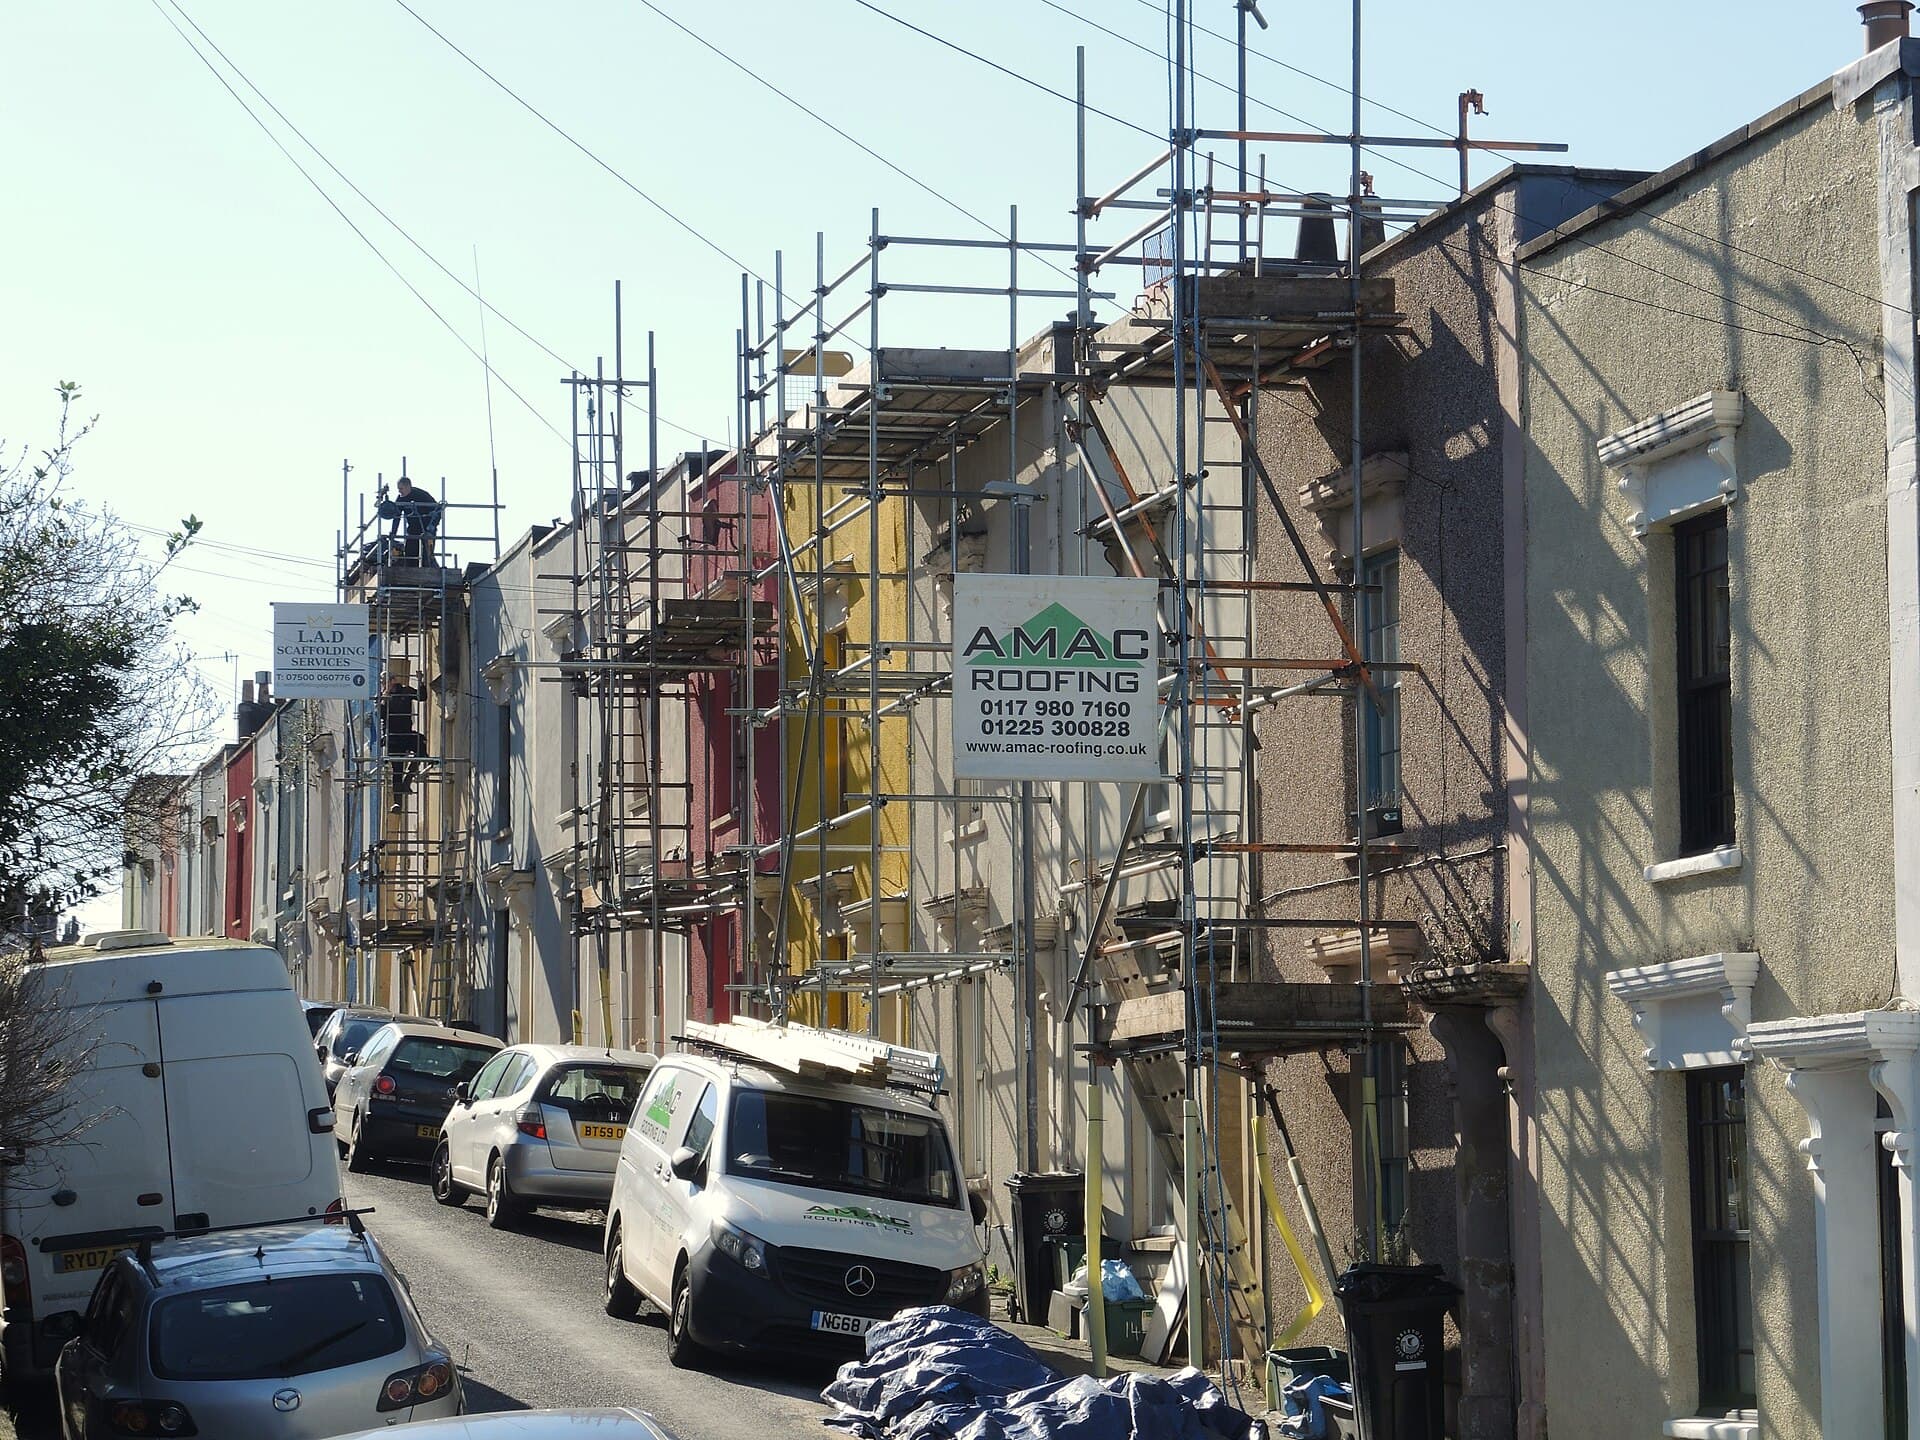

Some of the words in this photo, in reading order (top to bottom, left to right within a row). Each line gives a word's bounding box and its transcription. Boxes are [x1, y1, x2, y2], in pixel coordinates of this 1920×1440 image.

[297, 630, 344, 643] L.A.D
[962, 626, 1149, 660] AMAC
[277, 646, 365, 656] SCAFFOLDING
[291, 657, 351, 667] SERVICES
[286, 673, 315, 681] 07500
[971, 669, 1139, 693] ROOFING
[980, 699, 1028, 716] 0117
[1035, 700, 1075, 717] 980
[1082, 701, 1131, 717] 7160
[981, 719, 1044, 736] 01225
[1051, 720, 1131, 737] 300828
[966, 741, 1147, 757] www.amac-roofing.co.uk
[584, 1125, 614, 1138] BT59
[803, 1214, 877, 1229] ROOFING
[883, 1224, 915, 1236] LTD
[63, 1249, 108, 1271] RY07
[821, 1312, 861, 1333] NG68
